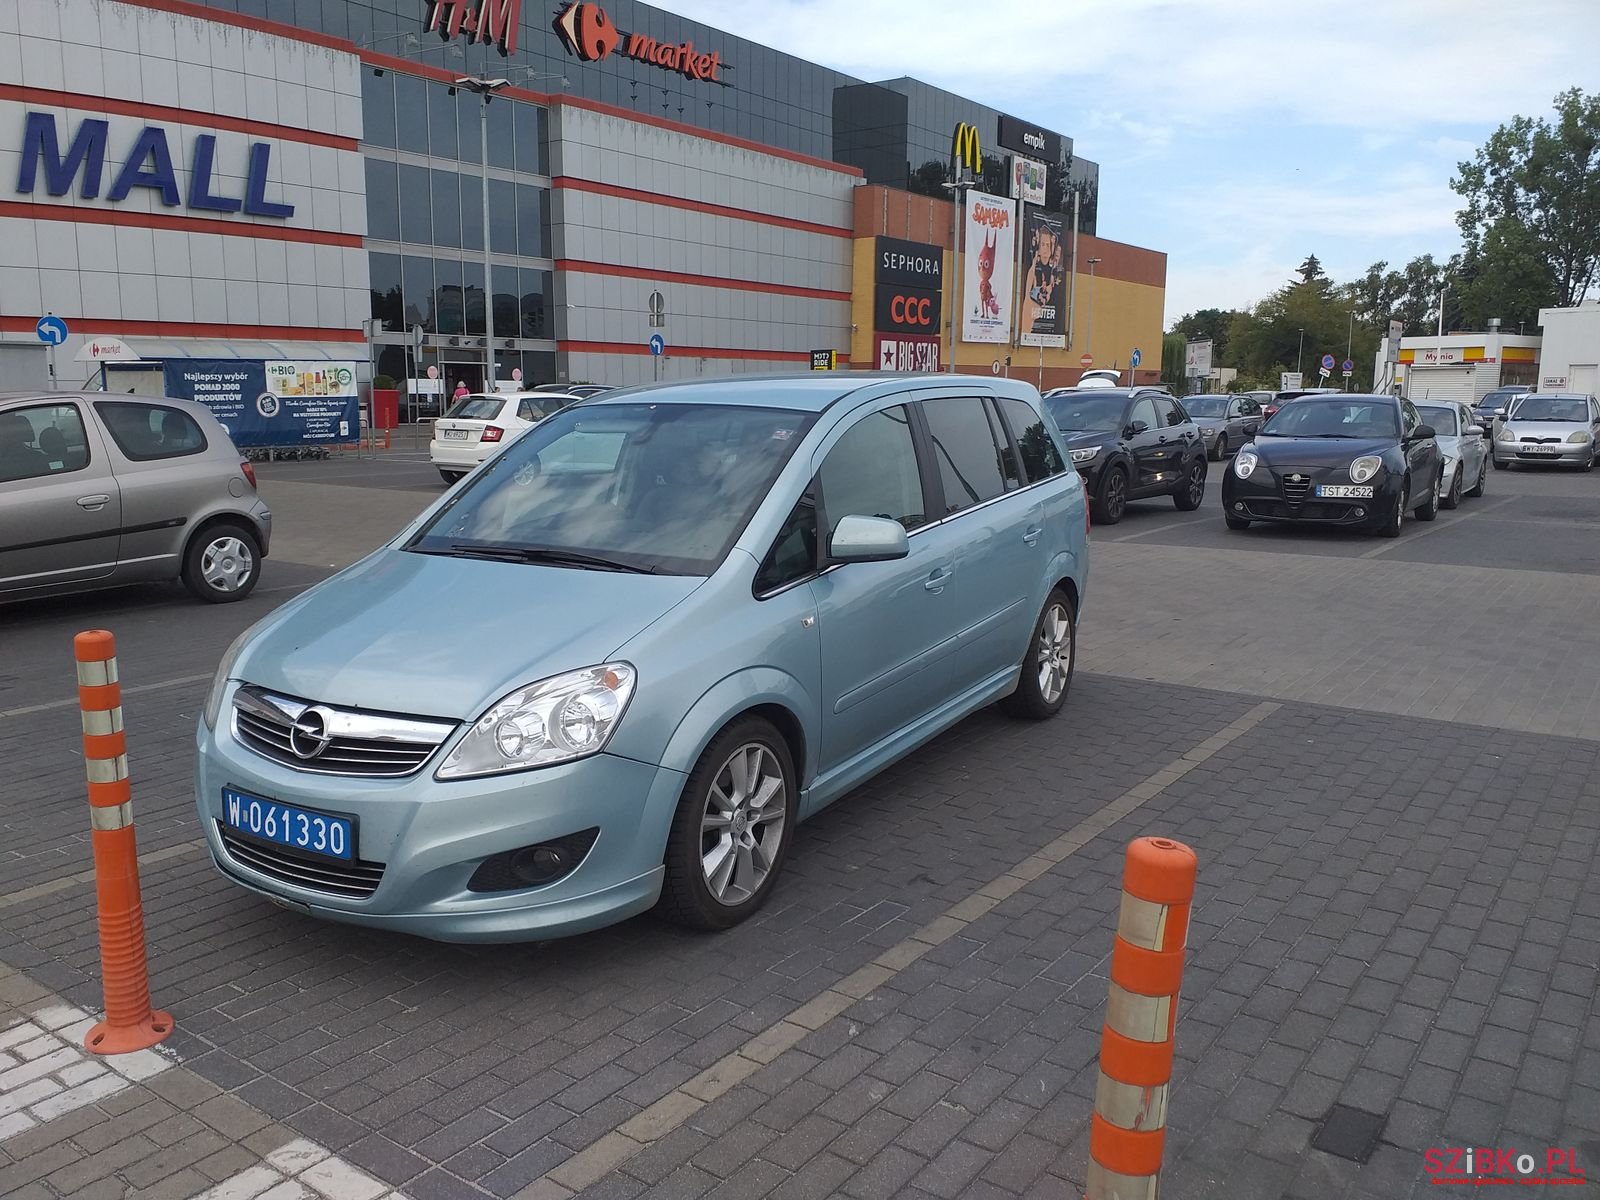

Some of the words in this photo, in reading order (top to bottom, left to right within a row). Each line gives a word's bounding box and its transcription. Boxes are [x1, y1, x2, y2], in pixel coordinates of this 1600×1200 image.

[628, 32, 720, 81] market
[1023, 132, 1046, 150] empik
[16, 112, 295, 218] MALL
[972, 202, 1010, 230] SAMSAM
[883, 252, 940, 275] SEPHORA
[891, 295, 931, 325] CCC
[898, 341, 914, 371] BIG
[916, 341, 939, 372] STAR
[184, 372, 223, 382] Najlepszy
[224, 372, 249, 382] wybór
[278, 365, 295, 375] BIO
[194, 383, 221, 391] PONAD
[222, 383, 241, 391] 2000
[194, 393, 242, 402] PRODUKTÓW
[1322, 486, 1340, 496] TST
[1343, 486, 1372, 497] 24522
[228, 794, 240, 828] W
[249, 801, 344, 855] 061330
